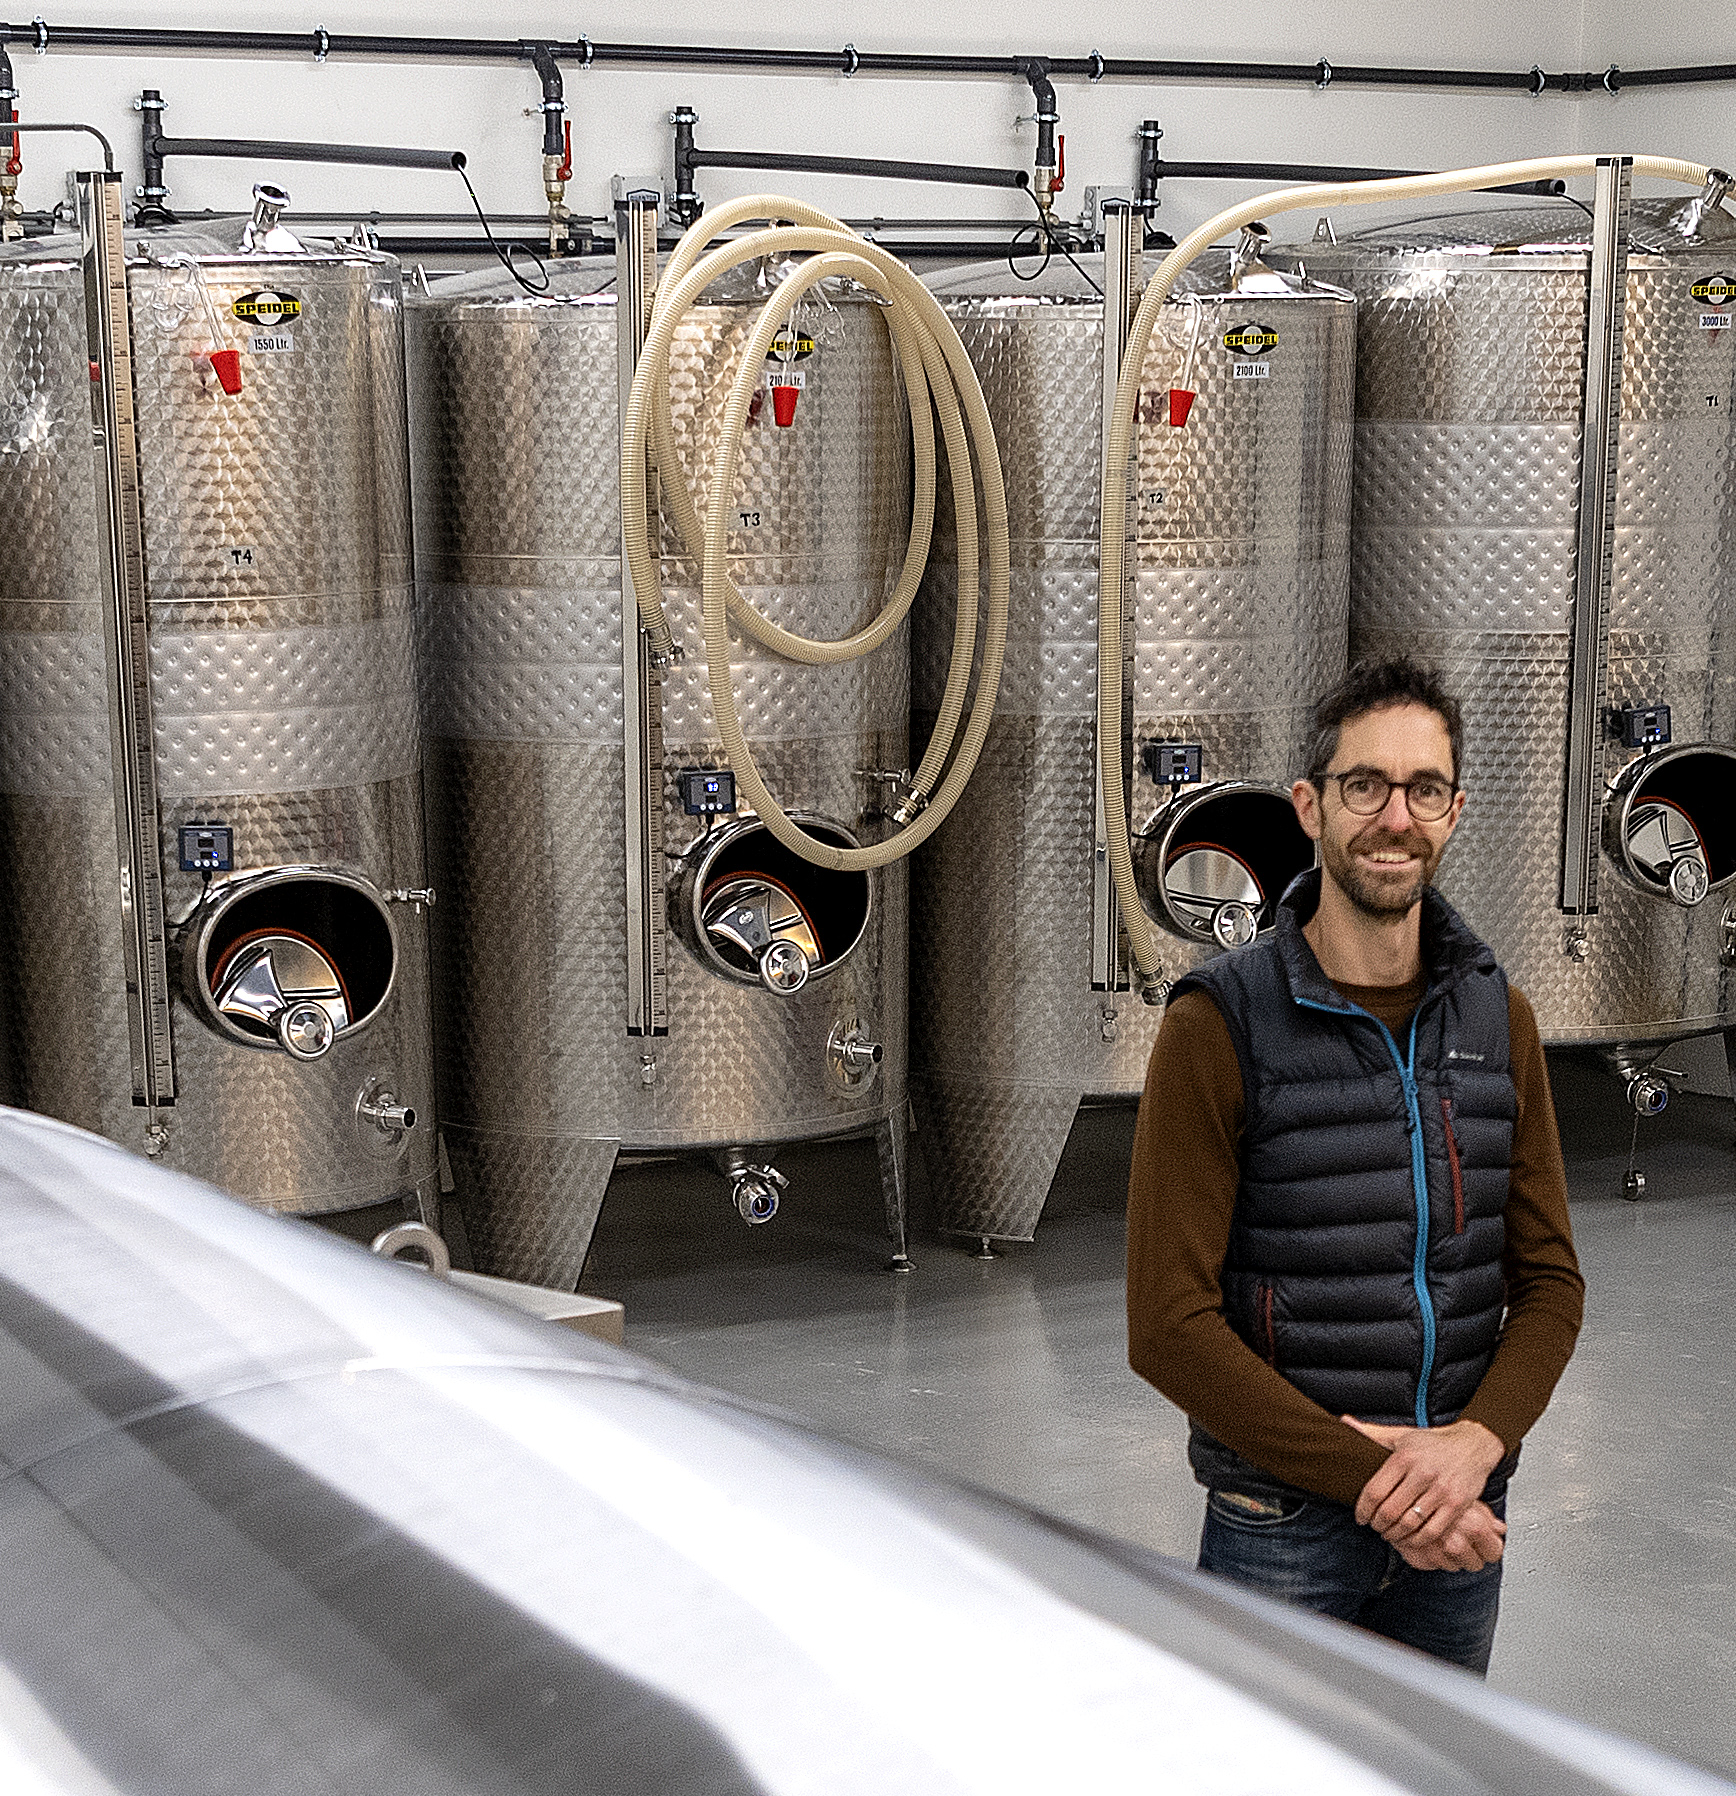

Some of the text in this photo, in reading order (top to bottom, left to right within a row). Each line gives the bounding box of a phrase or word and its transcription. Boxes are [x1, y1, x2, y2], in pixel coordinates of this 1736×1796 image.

[235, 303, 300, 315] SPEIDEL
[254, 337, 290, 351] 1550 Ltr.
[1226, 334, 1278, 346] SPEIDEL
[1236, 365, 1254, 377] 2100
[1149, 492, 1163, 504] T2
[739, 512, 761, 528] T3
[230, 549, 253, 565] T4
